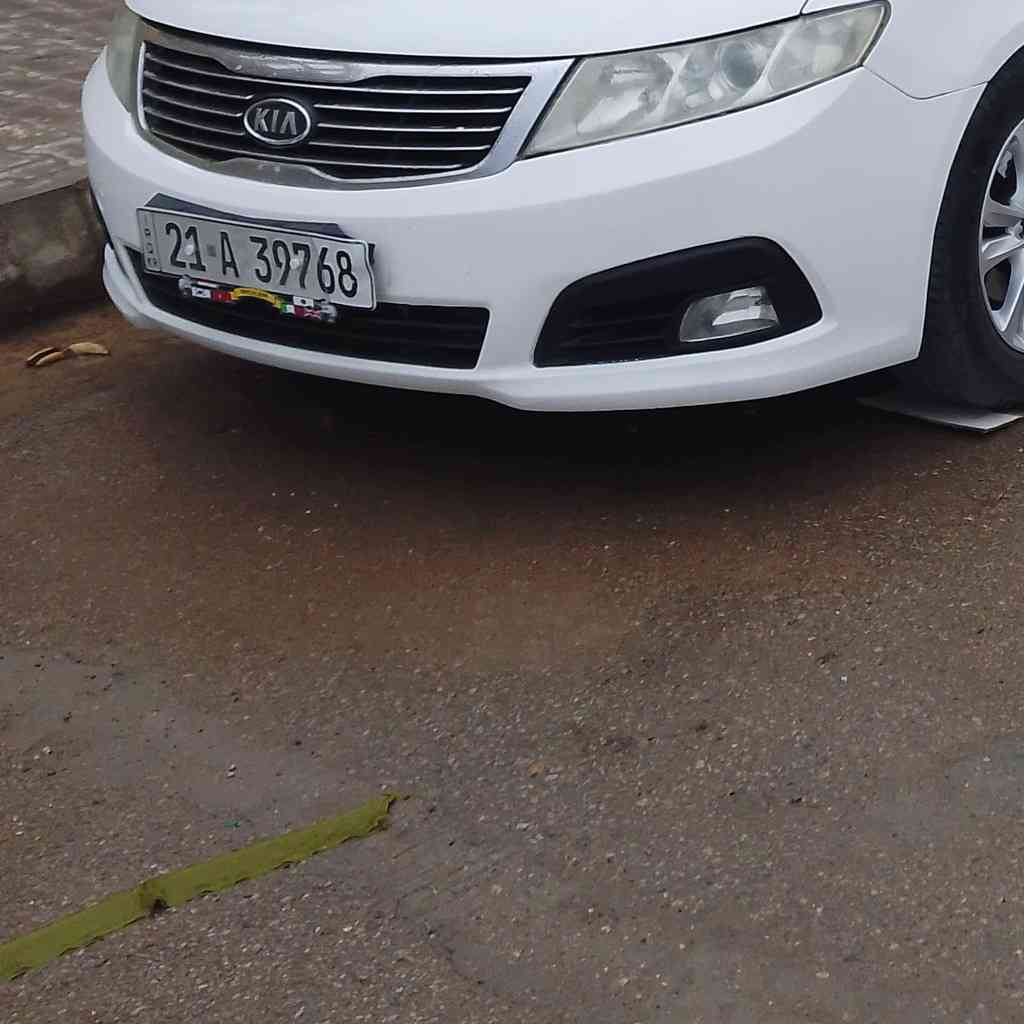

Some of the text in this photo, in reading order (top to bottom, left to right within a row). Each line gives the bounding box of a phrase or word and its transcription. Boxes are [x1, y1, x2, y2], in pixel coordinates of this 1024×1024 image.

[253, 107, 298, 136] KIA
[165, 222, 206, 272] 21
[220, 231, 240, 278] A
[249, 236, 358, 298] 39768
